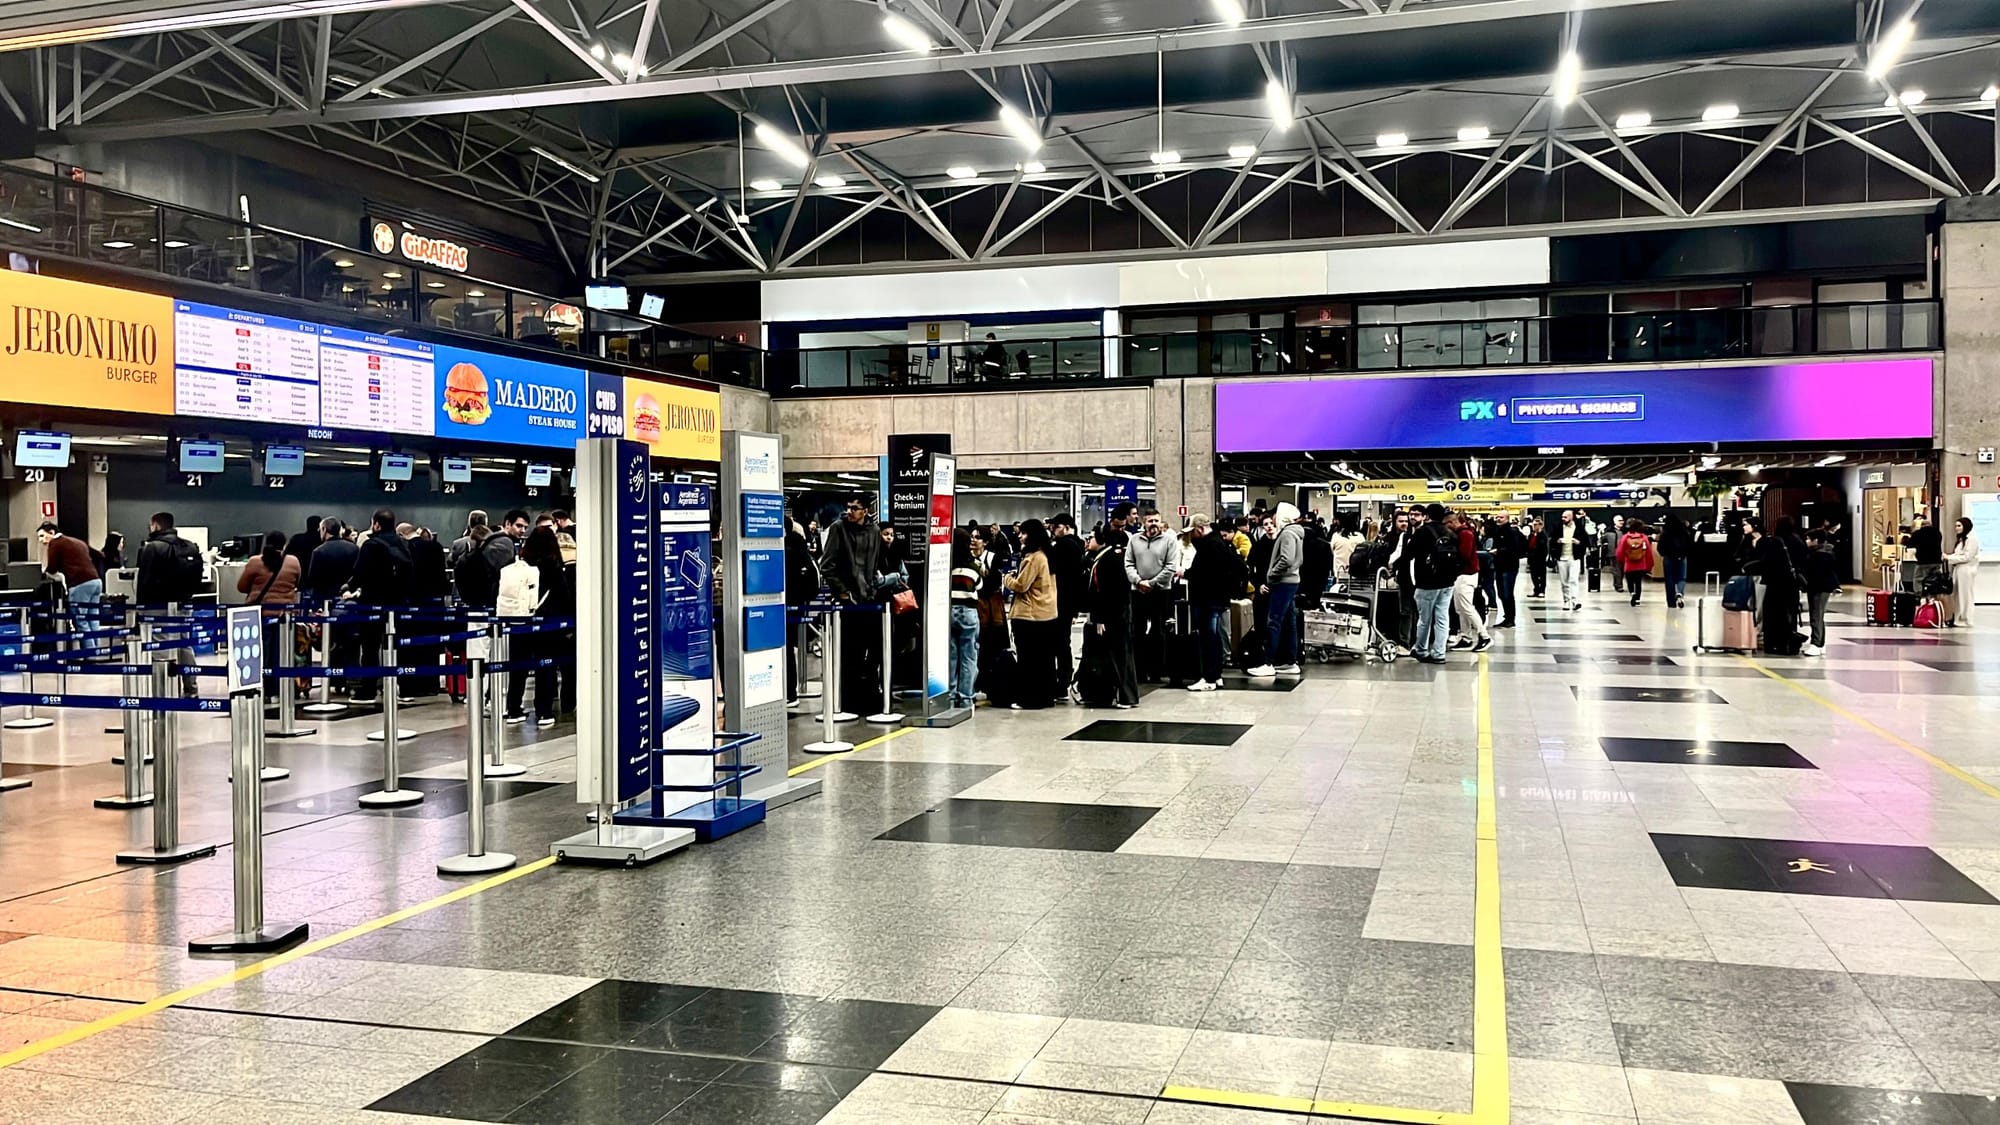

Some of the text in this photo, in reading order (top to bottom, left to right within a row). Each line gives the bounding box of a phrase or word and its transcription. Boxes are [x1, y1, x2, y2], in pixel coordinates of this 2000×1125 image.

[6, 304, 157, 366] JERONIMO
[107, 366, 157, 385] BURGER
[495, 379, 577, 414] MADERO
[595, 390, 617, 412] CWB
[1461, 401, 1495, 420] PX
[1518, 402, 1637, 416] PHYGITAL SIGNAGE
[528, 415, 577, 430] STEAK HOUSE
[665, 403, 715, 433] JERONIMO
[601, 414, 623, 436] PISO
[307, 429, 333, 440] NEOOH
[24, 469, 45, 482] 20
[186, 474, 202, 487] 21
[269, 476, 285, 488] 22
[384, 481, 397, 492] 23
[444, 484, 455, 494] 24
[527, 487, 538, 497] 25
[893, 492, 925, 501] Check-in
[893, 501, 925, 510] Premium
[930, 516, 940, 526] SKY
